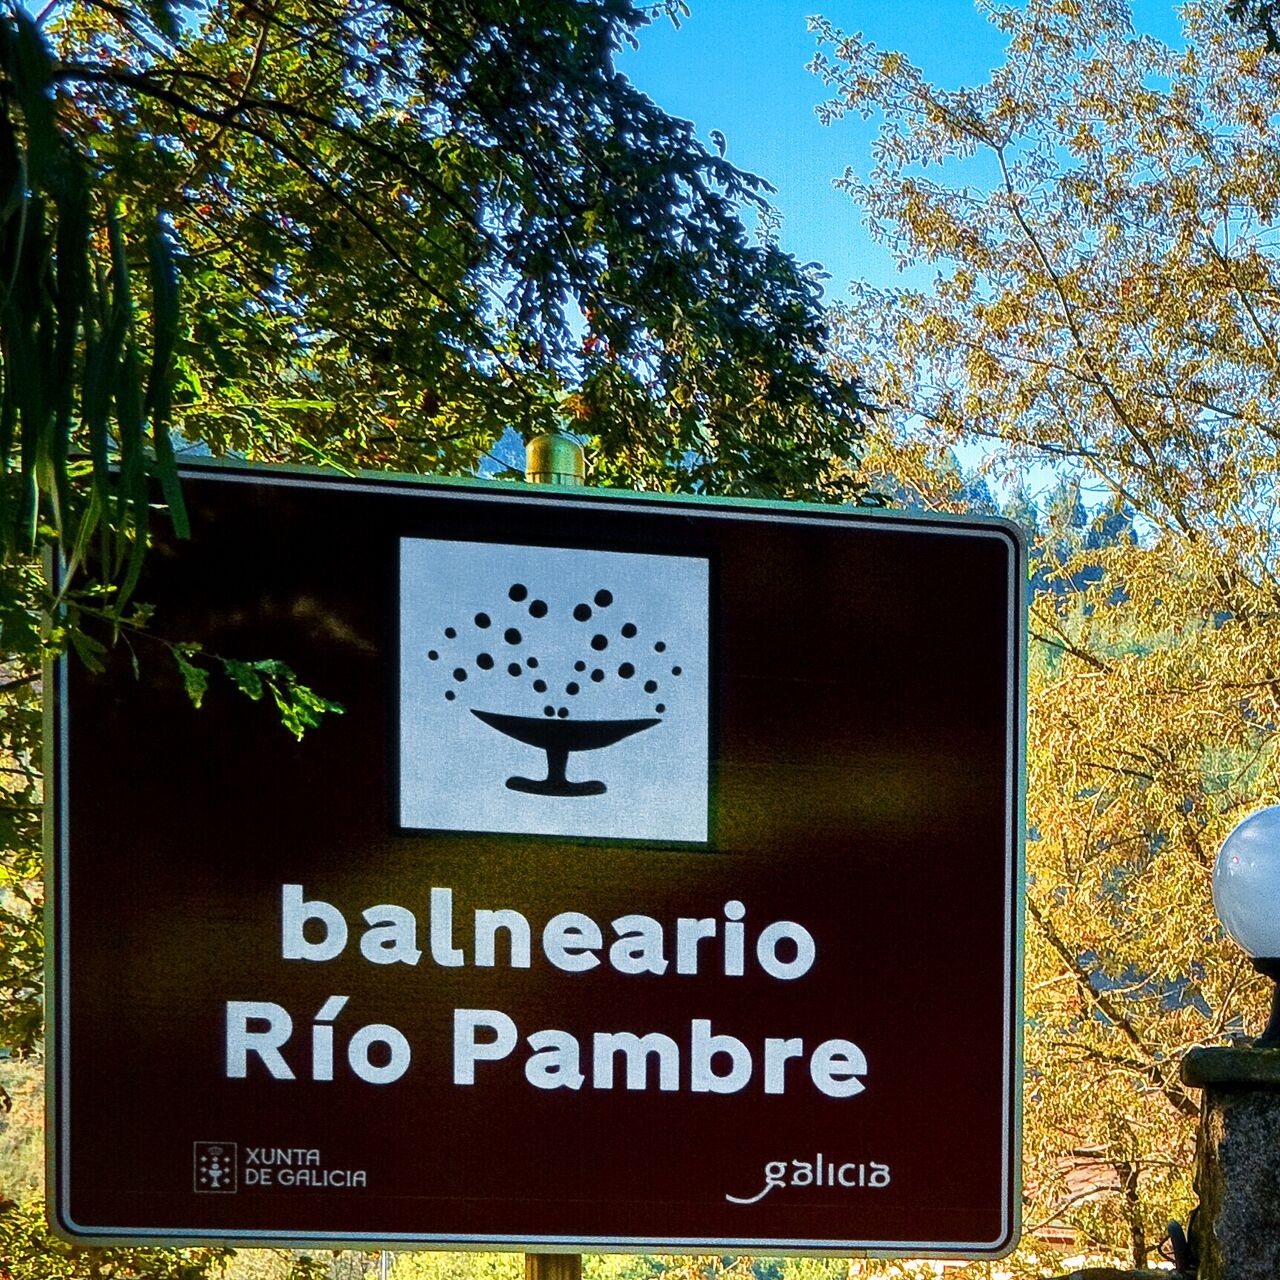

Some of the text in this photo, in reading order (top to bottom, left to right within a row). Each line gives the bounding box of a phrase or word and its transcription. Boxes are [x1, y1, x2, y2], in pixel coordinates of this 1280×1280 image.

[281, 883, 816, 980] balneario
[226, 995, 868, 1098] Río Pambre
[245, 1168, 367, 1187] DE GALICIA
[246, 1147, 320, 1166] XUNTA
[726, 1152, 891, 1204] galicia
